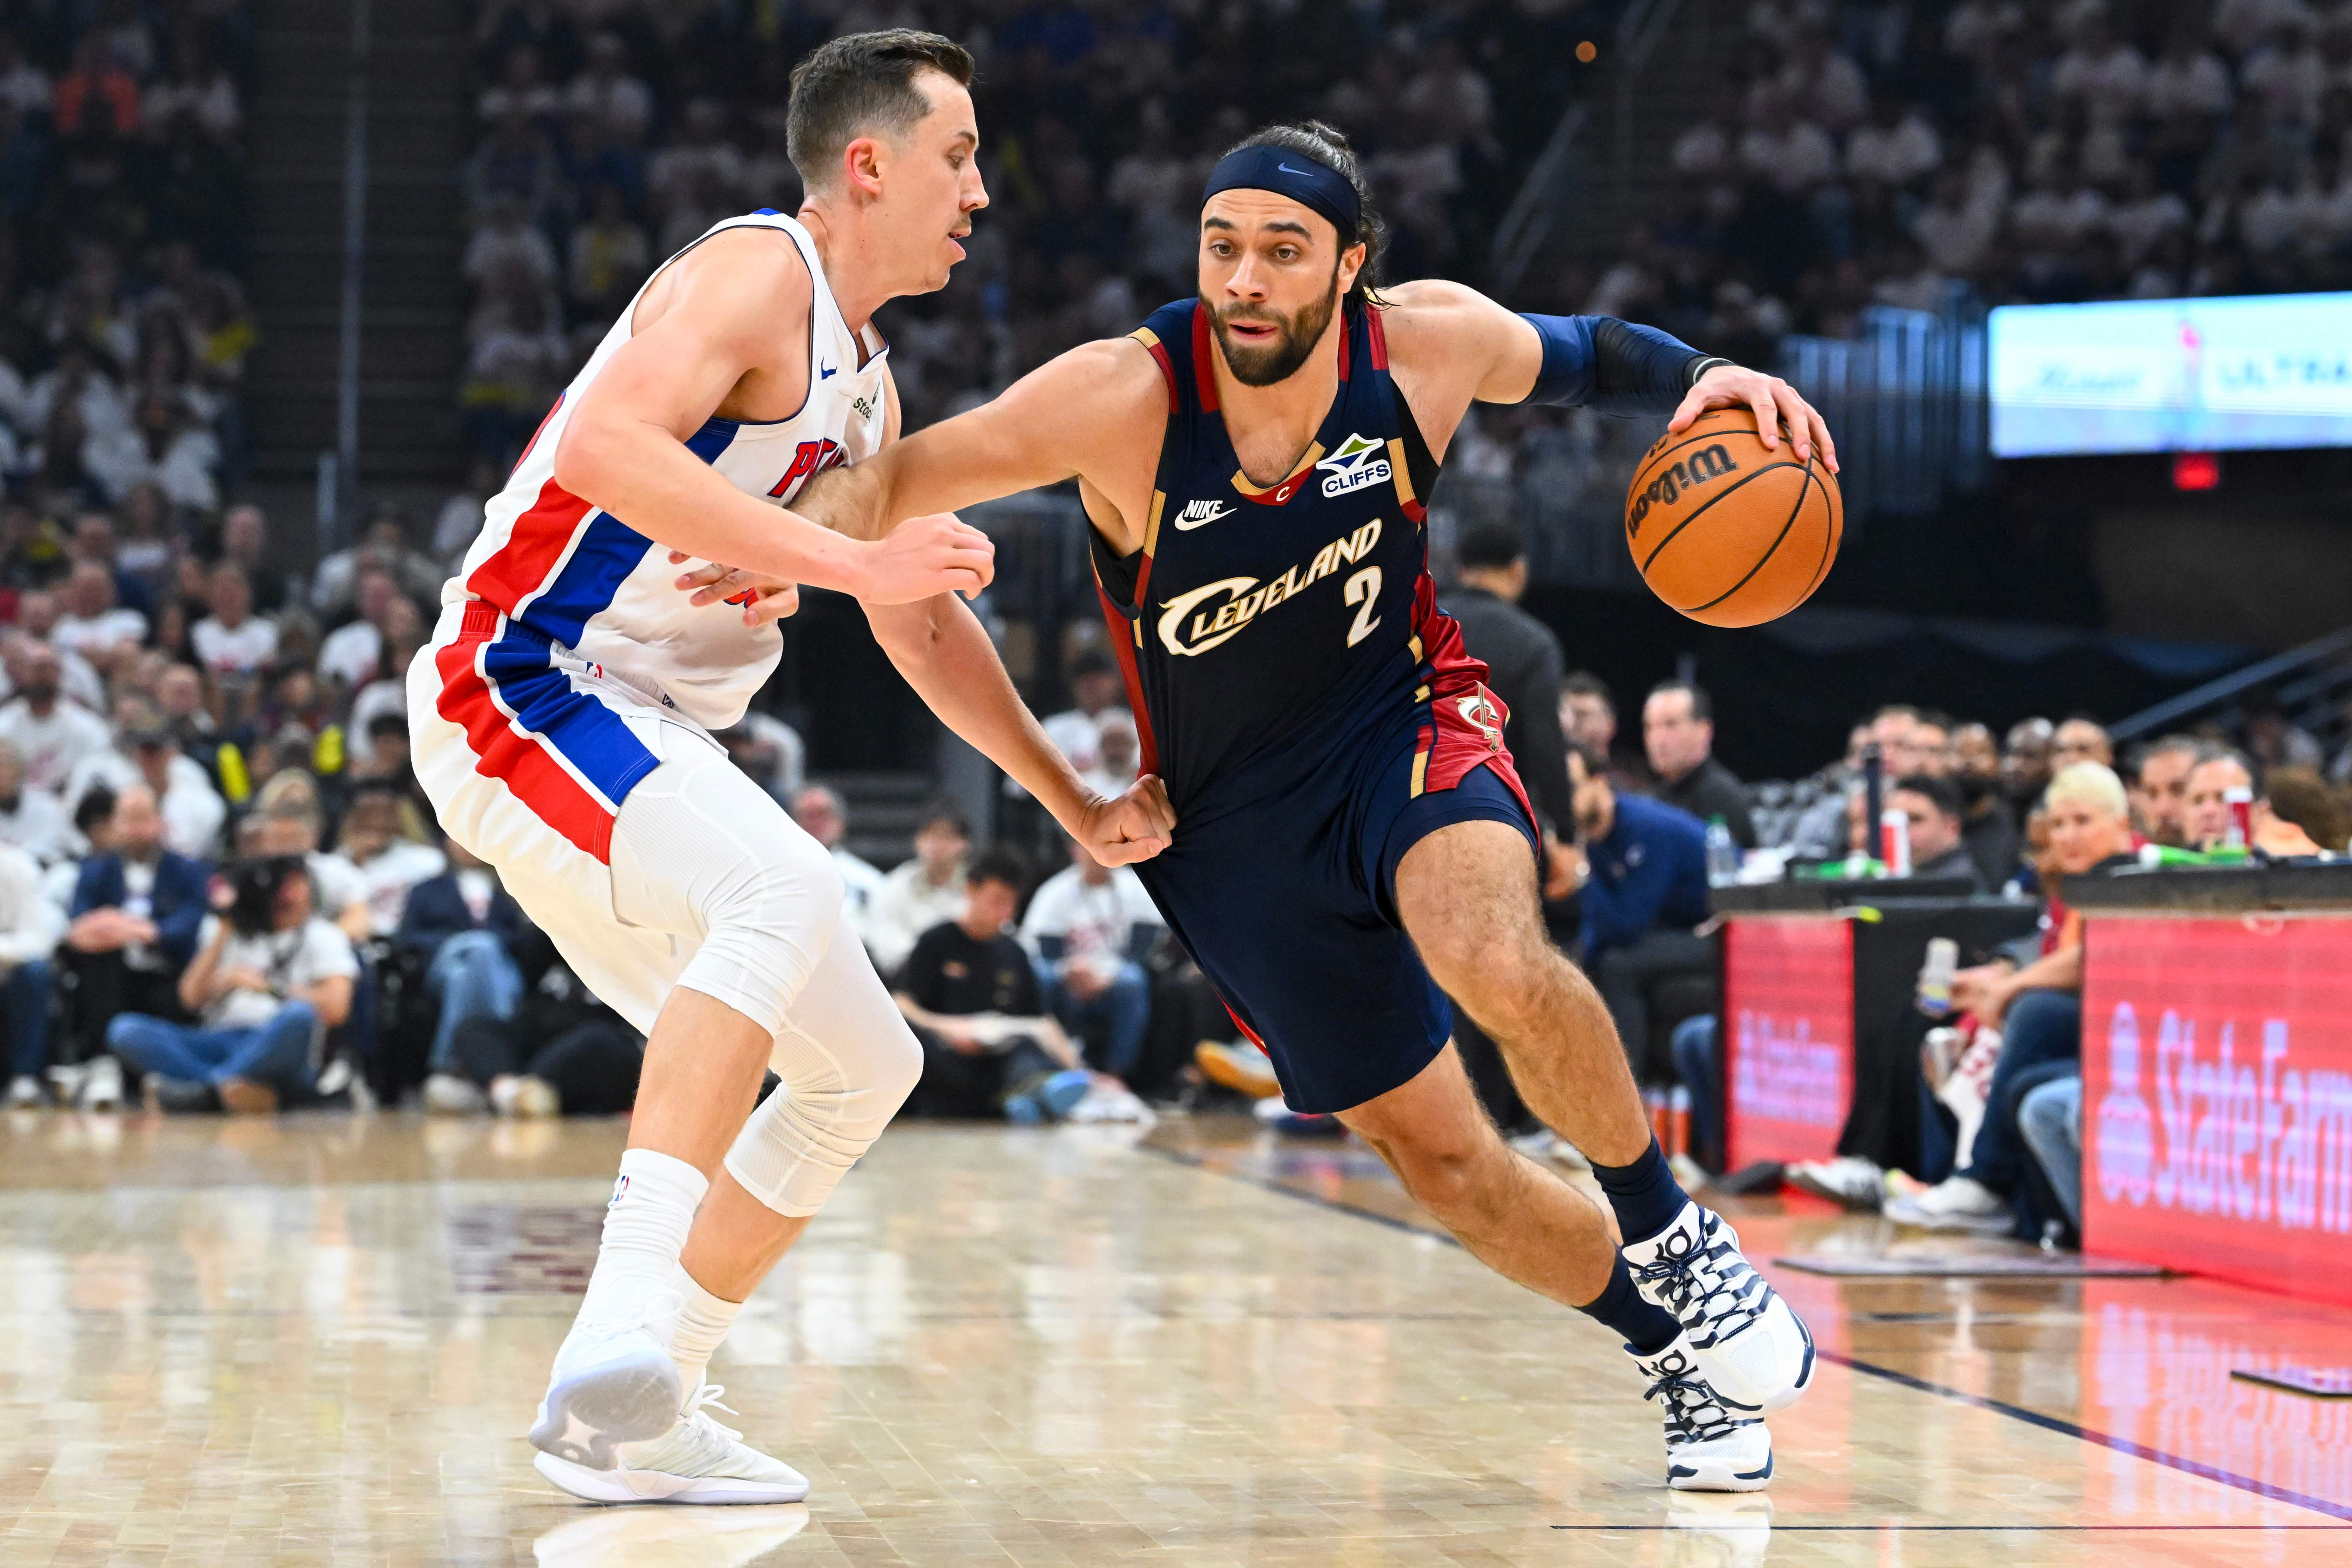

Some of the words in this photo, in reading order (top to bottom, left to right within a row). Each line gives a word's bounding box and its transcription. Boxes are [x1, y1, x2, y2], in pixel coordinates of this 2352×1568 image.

[1276, 486, 1290, 502] C
[1325, 464, 1389, 493] CLIFFS
[1628, 444, 1739, 539] Wilson
[1184, 499, 1223, 518] NIKE
[1158, 518, 1382, 656] CLEVELAND
[1344, 566, 1382, 648] 2
